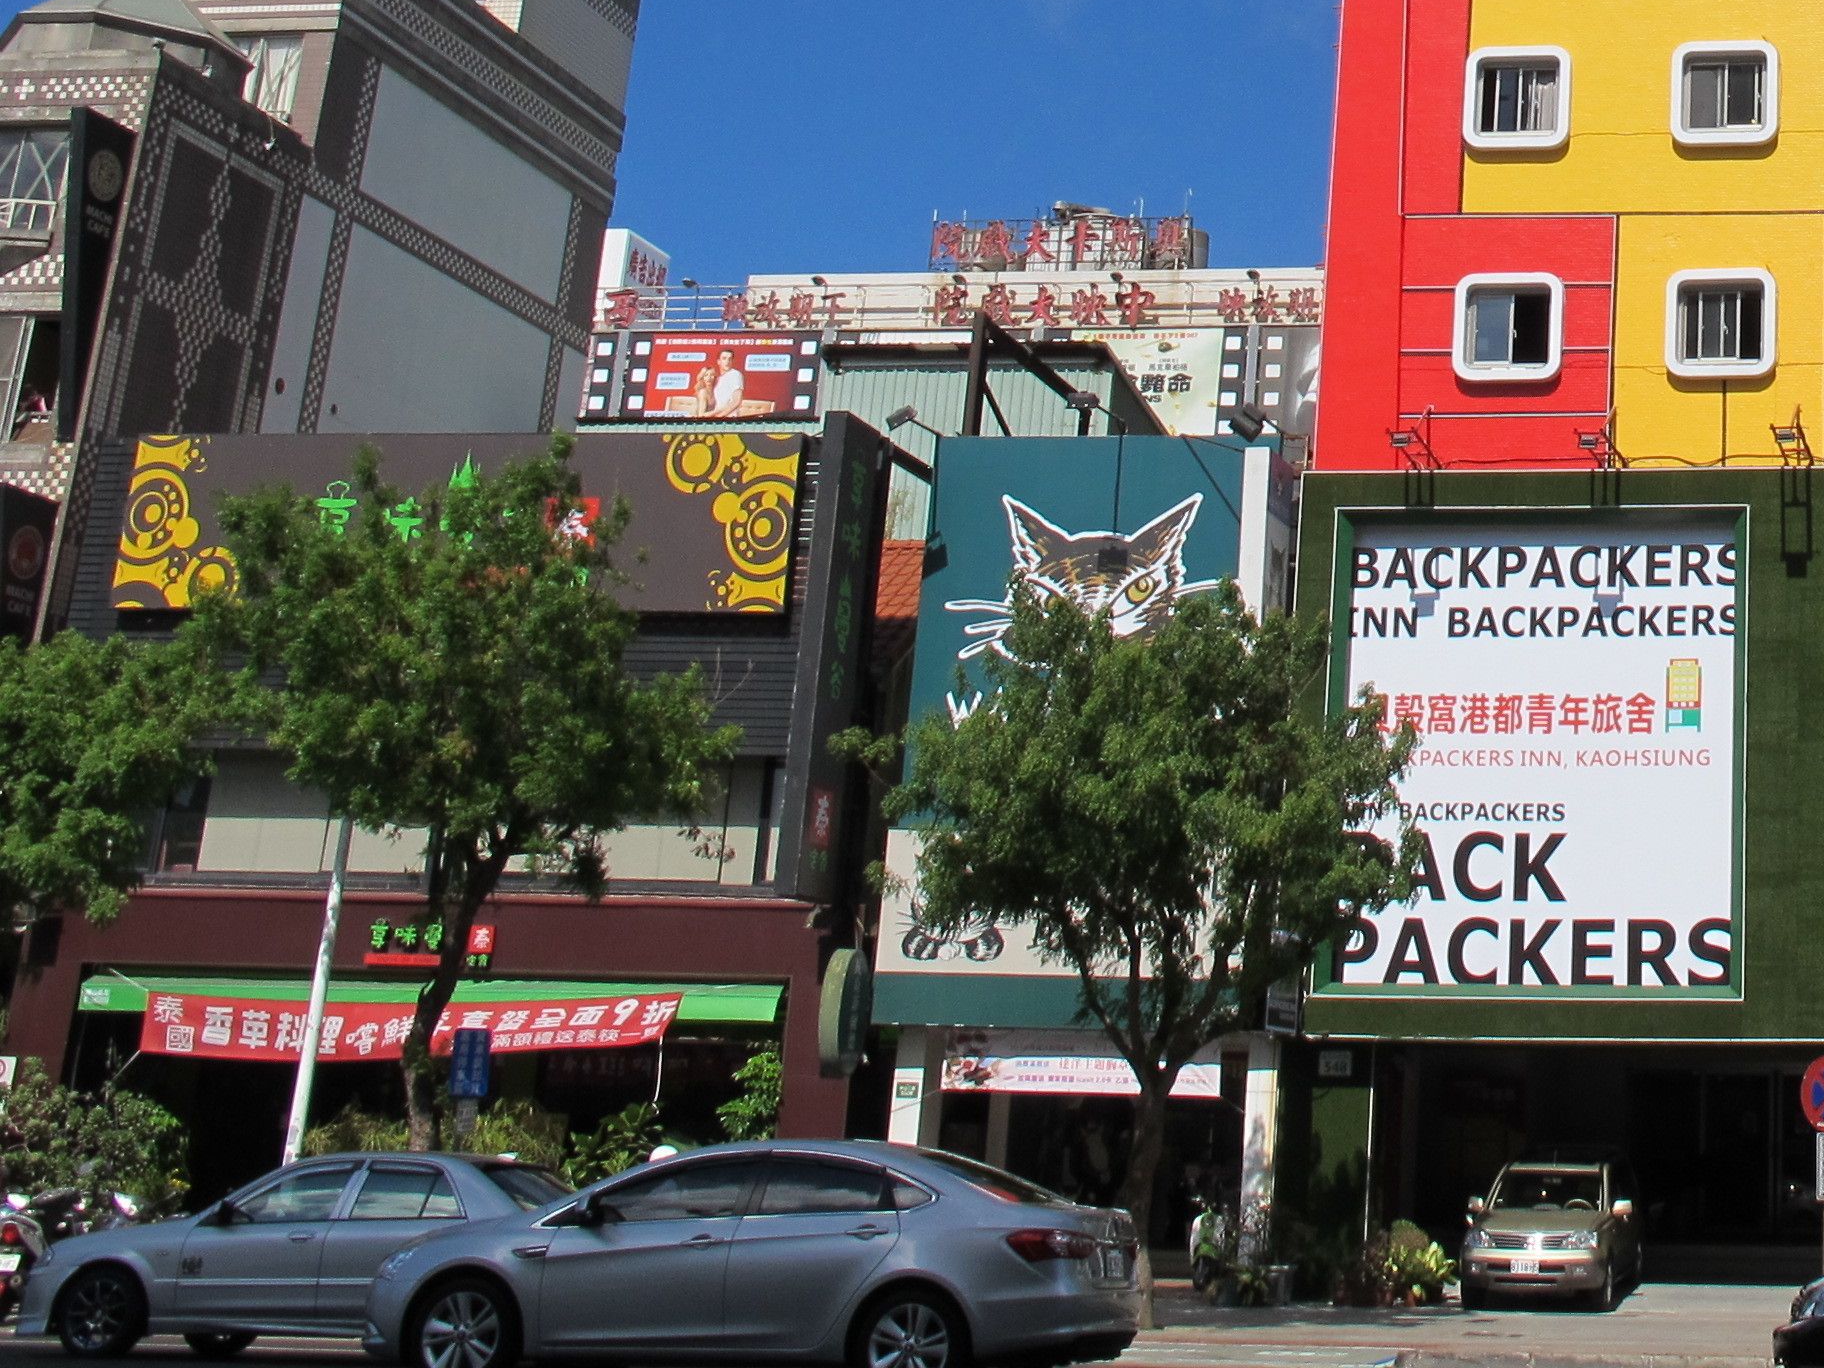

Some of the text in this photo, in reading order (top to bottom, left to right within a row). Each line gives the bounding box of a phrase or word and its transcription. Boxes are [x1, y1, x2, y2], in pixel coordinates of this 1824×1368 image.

[1351, 544, 1737, 592] BACKPACKERS
[1348, 603, 1737, 639] INN BACKPACKERS
[1520, 749, 1568, 770] INN,
[1575, 748, 1711, 768] KAOHSIUNG
[1399, 801, 1566, 823] BACKPACKERS
[1336, 917, 1732, 988] PACKERS
[153, 995, 195, 1053] 泰國
